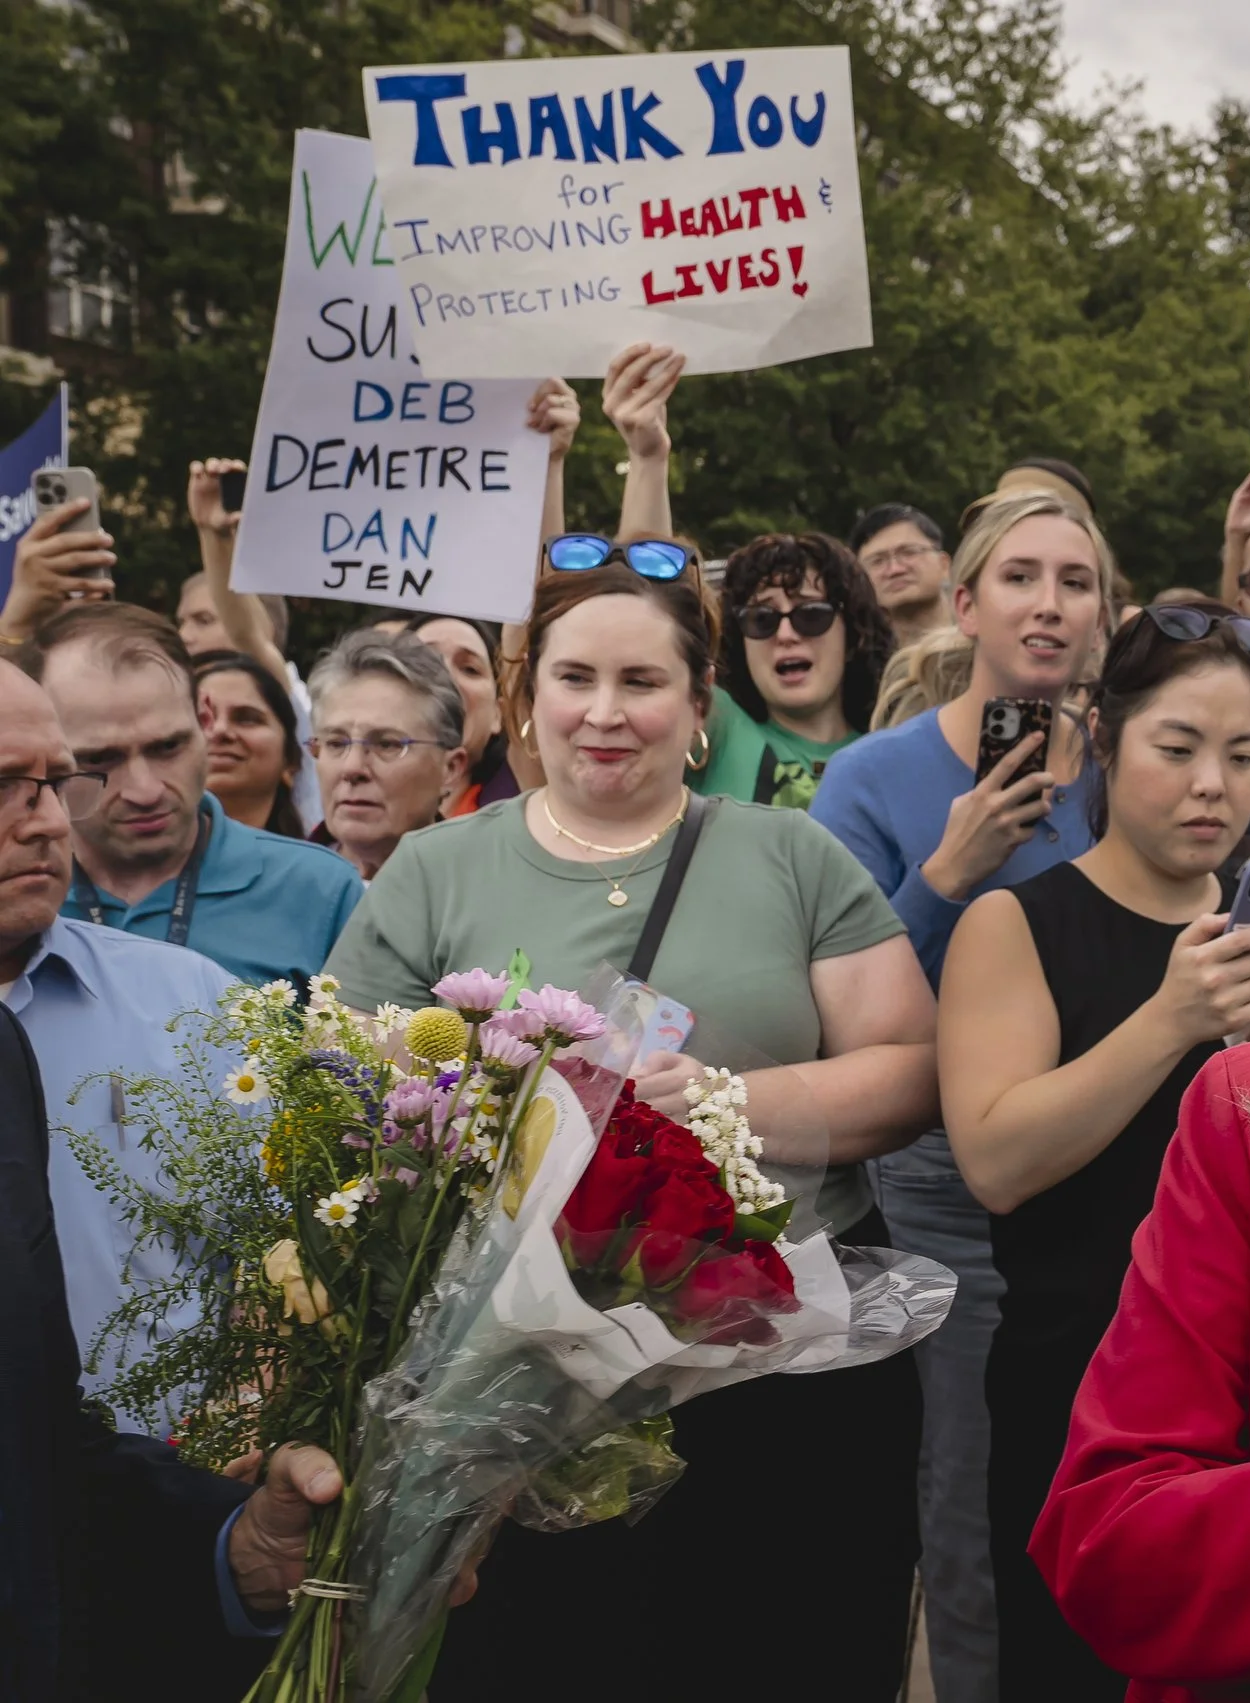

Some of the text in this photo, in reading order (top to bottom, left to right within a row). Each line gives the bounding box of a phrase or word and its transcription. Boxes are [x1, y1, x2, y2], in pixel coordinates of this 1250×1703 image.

[375, 59, 827, 169] THANK YOU
[558, 174, 625, 208] for
[394, 215, 632, 262] IMPROVING
[640, 185, 806, 240] HEALTH
[409, 245, 811, 327] PROTECTING LIVES!
[354, 381, 476, 424] DEB
[266, 434, 512, 493] DEMETRE
[322, 509, 438, 560] DAN
[323, 561, 433, 597] JEN
